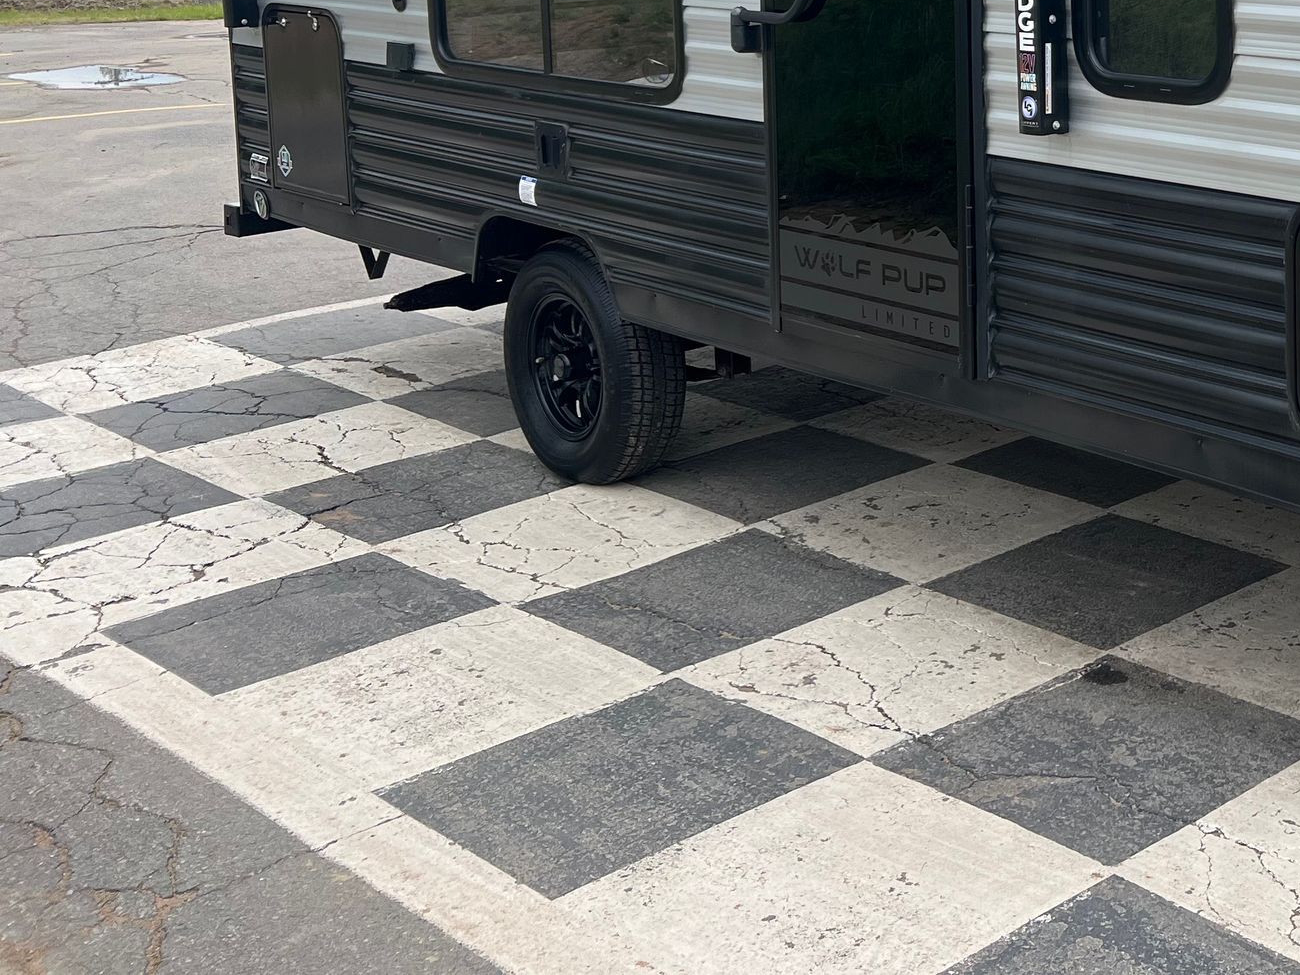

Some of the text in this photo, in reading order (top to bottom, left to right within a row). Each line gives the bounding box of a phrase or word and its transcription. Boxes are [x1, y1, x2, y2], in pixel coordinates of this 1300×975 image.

[1019, 53, 1036, 74] 12V
[881, 263, 946, 296] PUP
[861, 305, 950, 338] LIMITED
